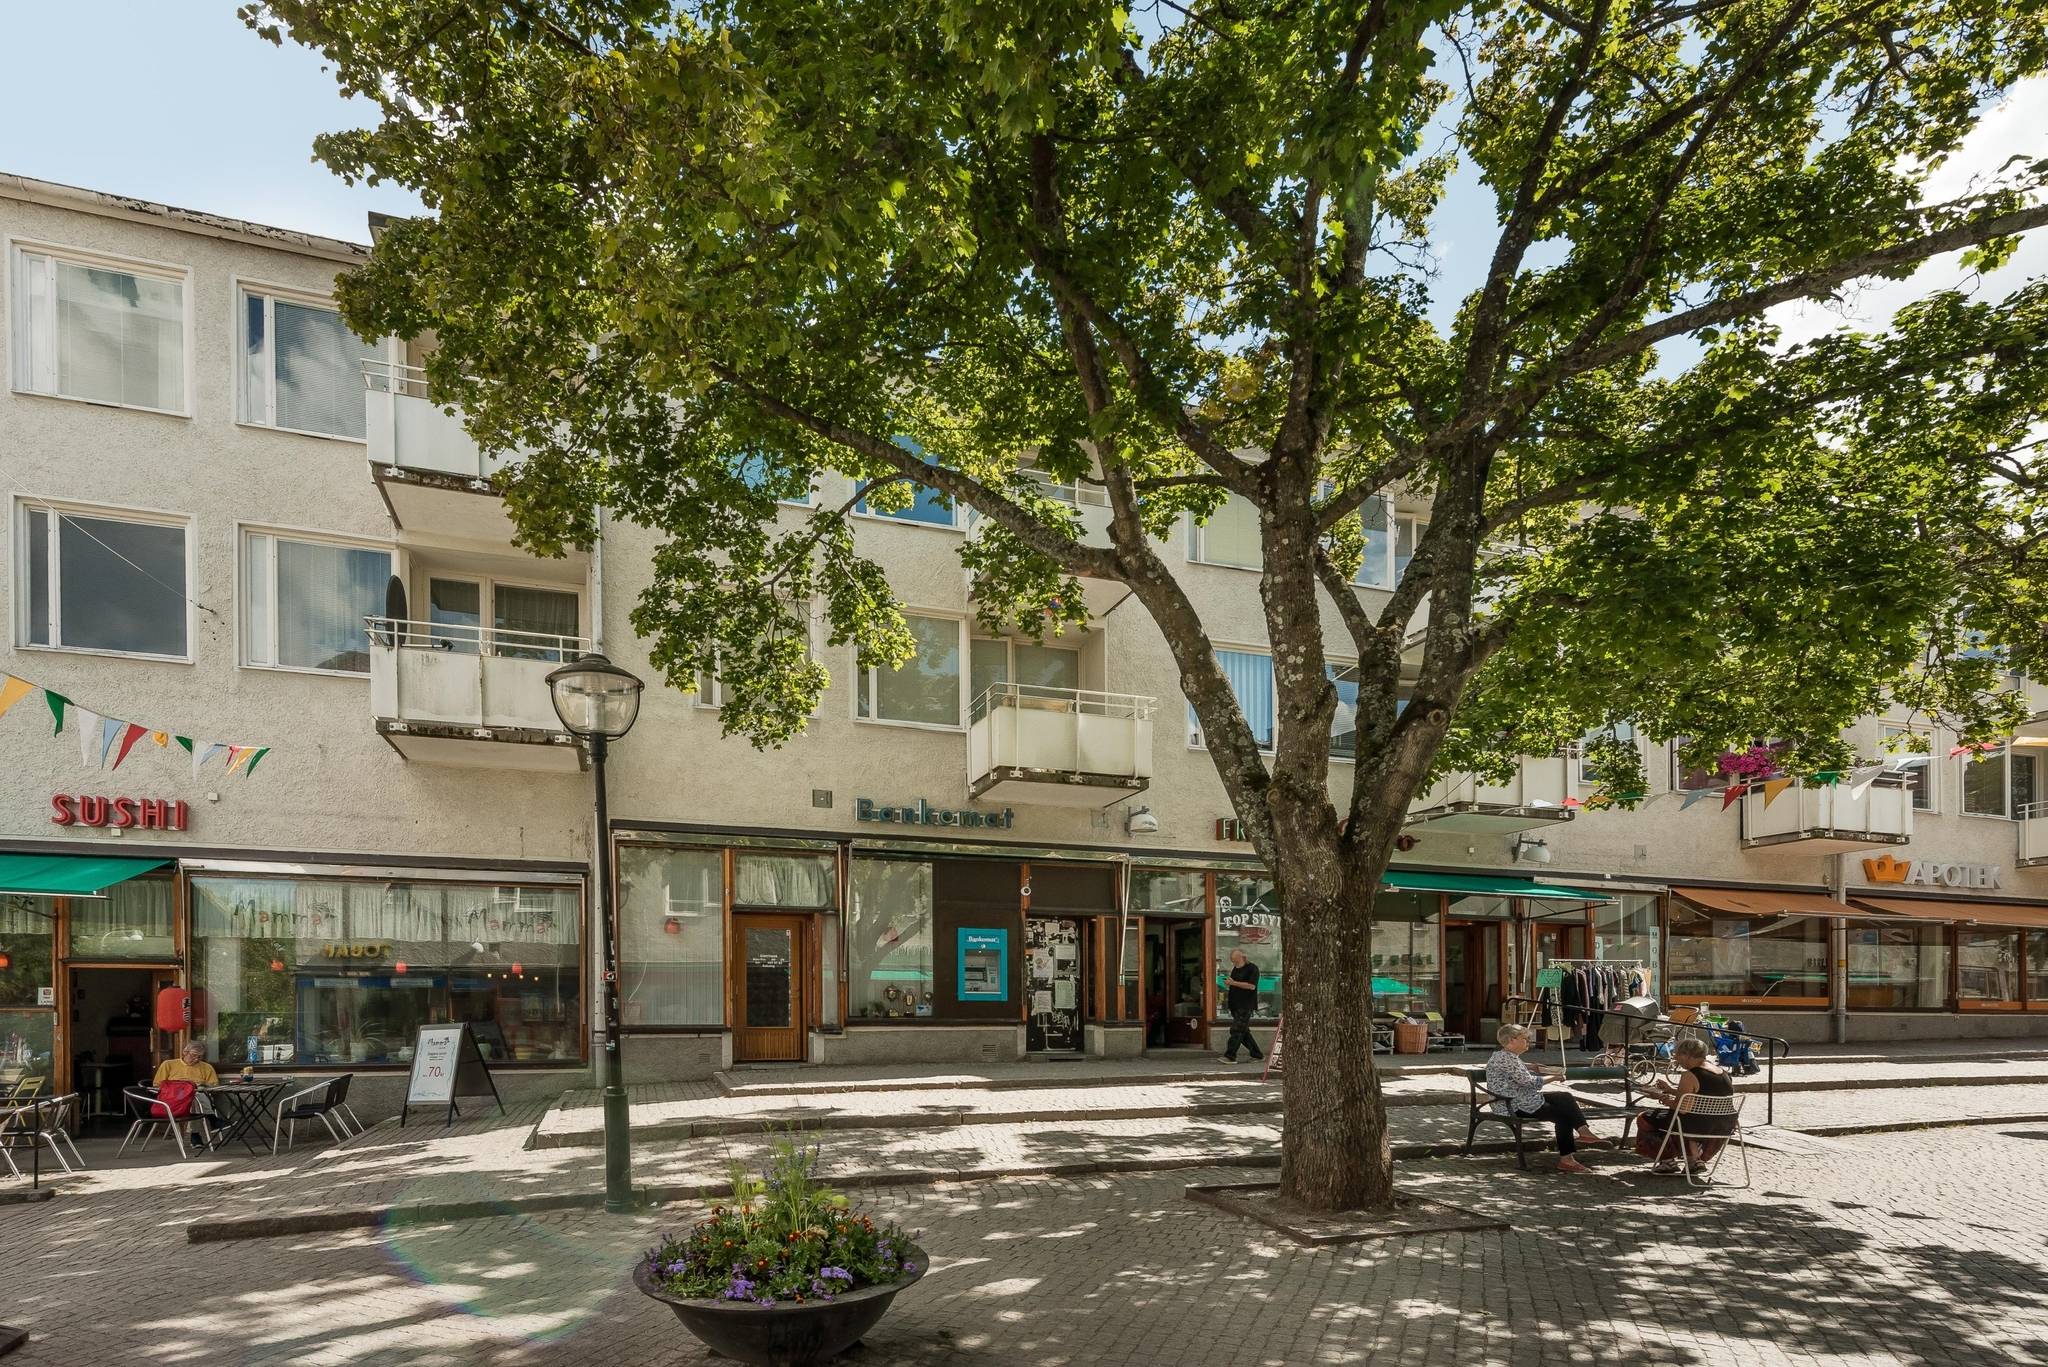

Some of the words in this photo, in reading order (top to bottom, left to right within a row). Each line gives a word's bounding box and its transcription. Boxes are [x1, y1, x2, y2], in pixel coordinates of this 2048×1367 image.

[51, 793, 189, 832] SUSHI
[855, 798, 1014, 829] Bankomat
[1904, 860, 2001, 889] APOTEK
[1223, 913, 1250, 929] TOP
[428, 1066, 442, 1078] 70
